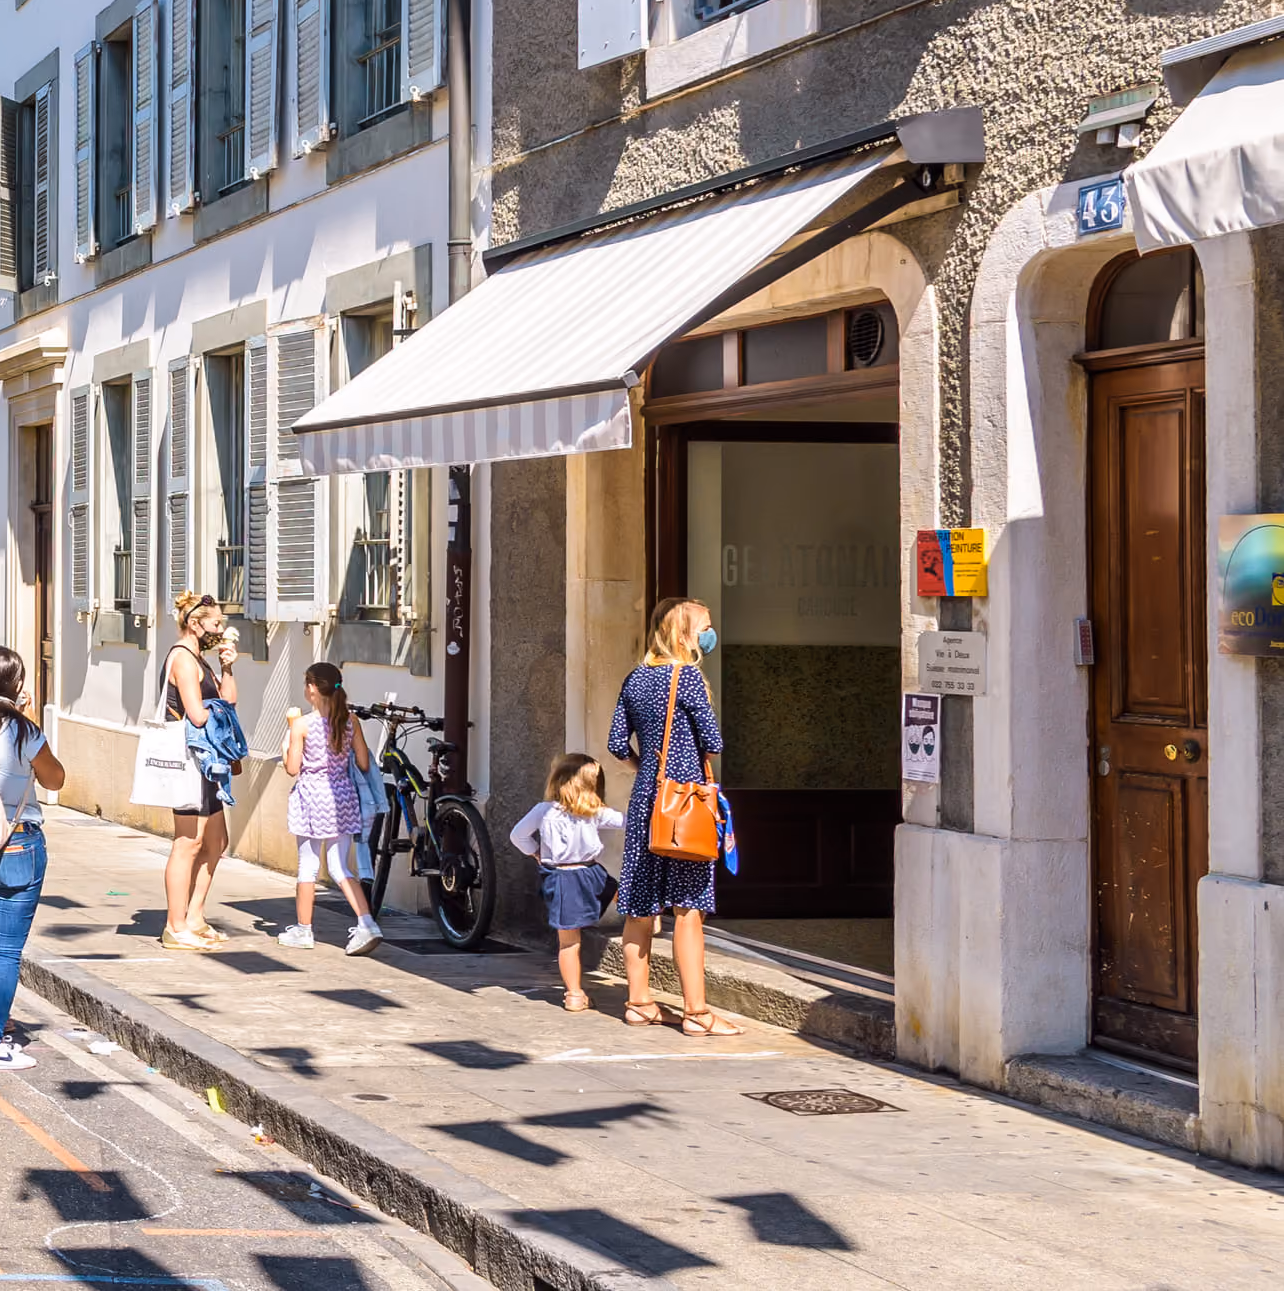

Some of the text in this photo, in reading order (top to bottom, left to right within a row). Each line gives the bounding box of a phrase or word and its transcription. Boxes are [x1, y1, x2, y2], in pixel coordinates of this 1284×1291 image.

[1082, 187, 1119, 227] 43
[945, 542, 983, 553] PEINTURE
[942, 636, 963, 646] Agence
